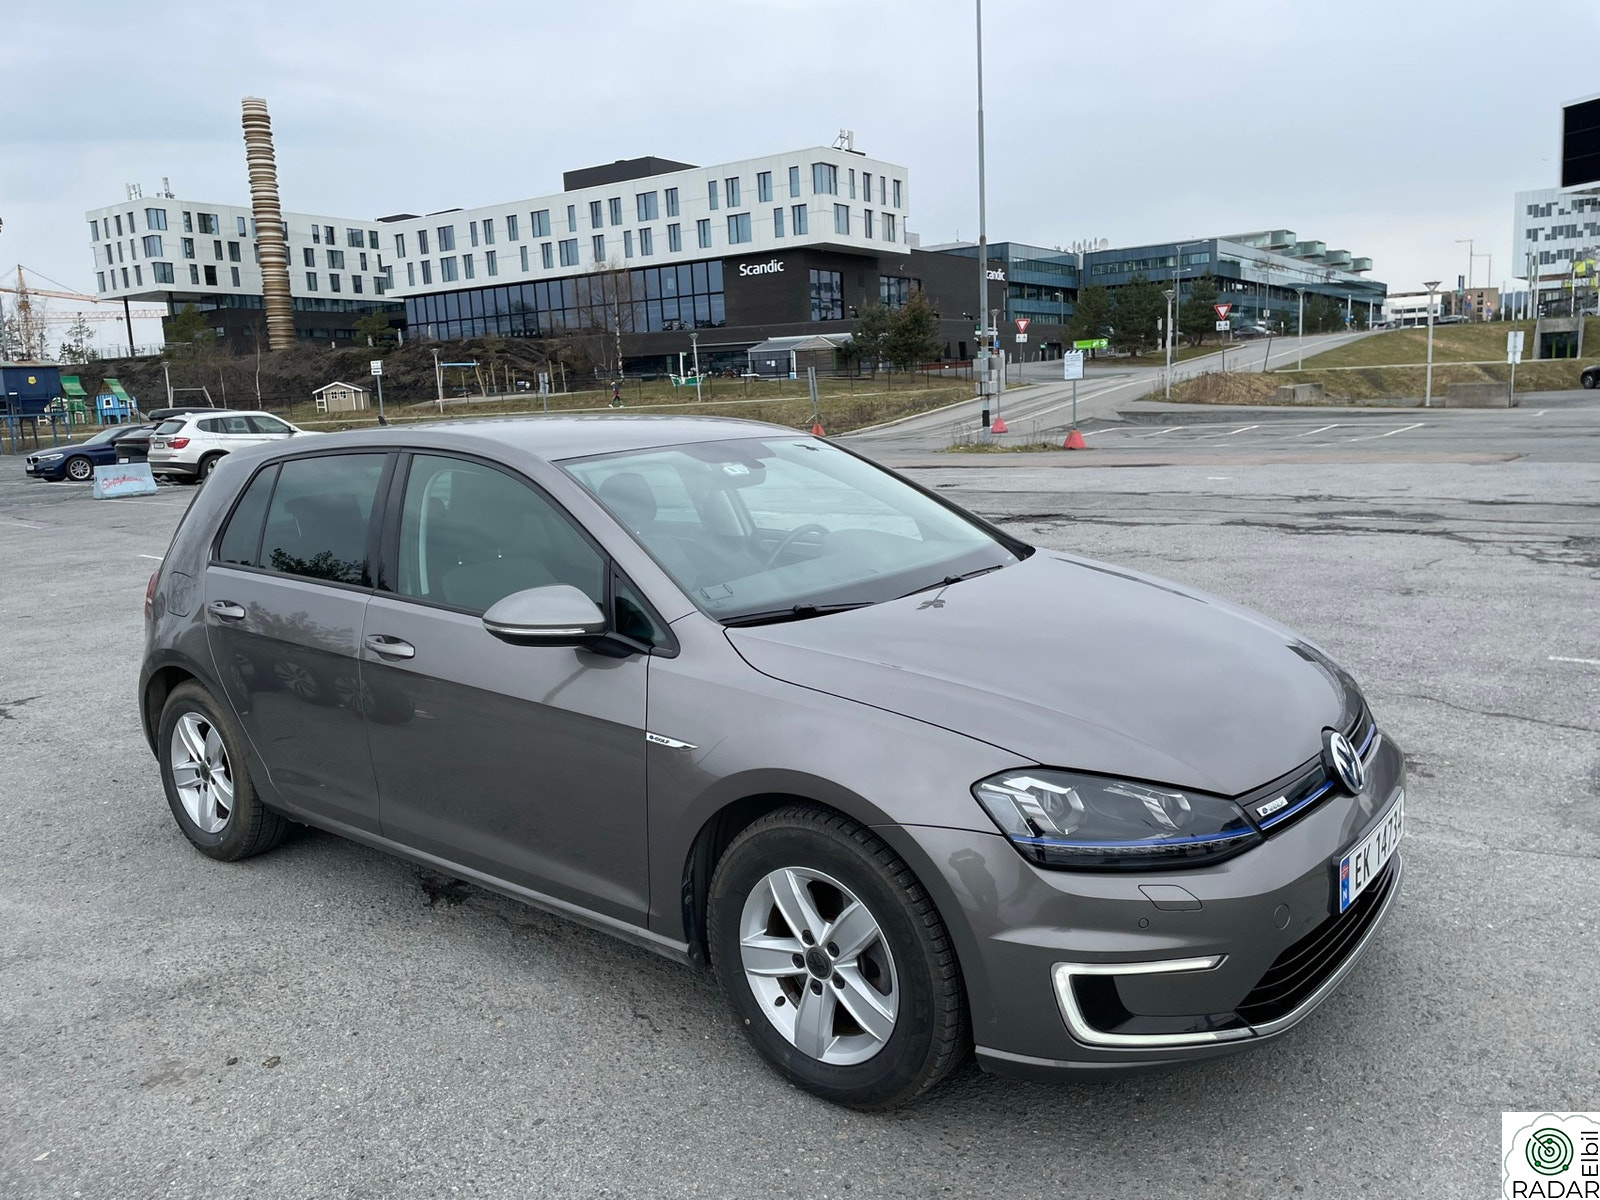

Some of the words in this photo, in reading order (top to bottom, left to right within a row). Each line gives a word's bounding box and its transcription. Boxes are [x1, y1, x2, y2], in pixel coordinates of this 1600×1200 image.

[739, 259, 785, 276] Scandic
[986, 268, 1005, 281] candic
[1355, 843, 1371, 890] EK
